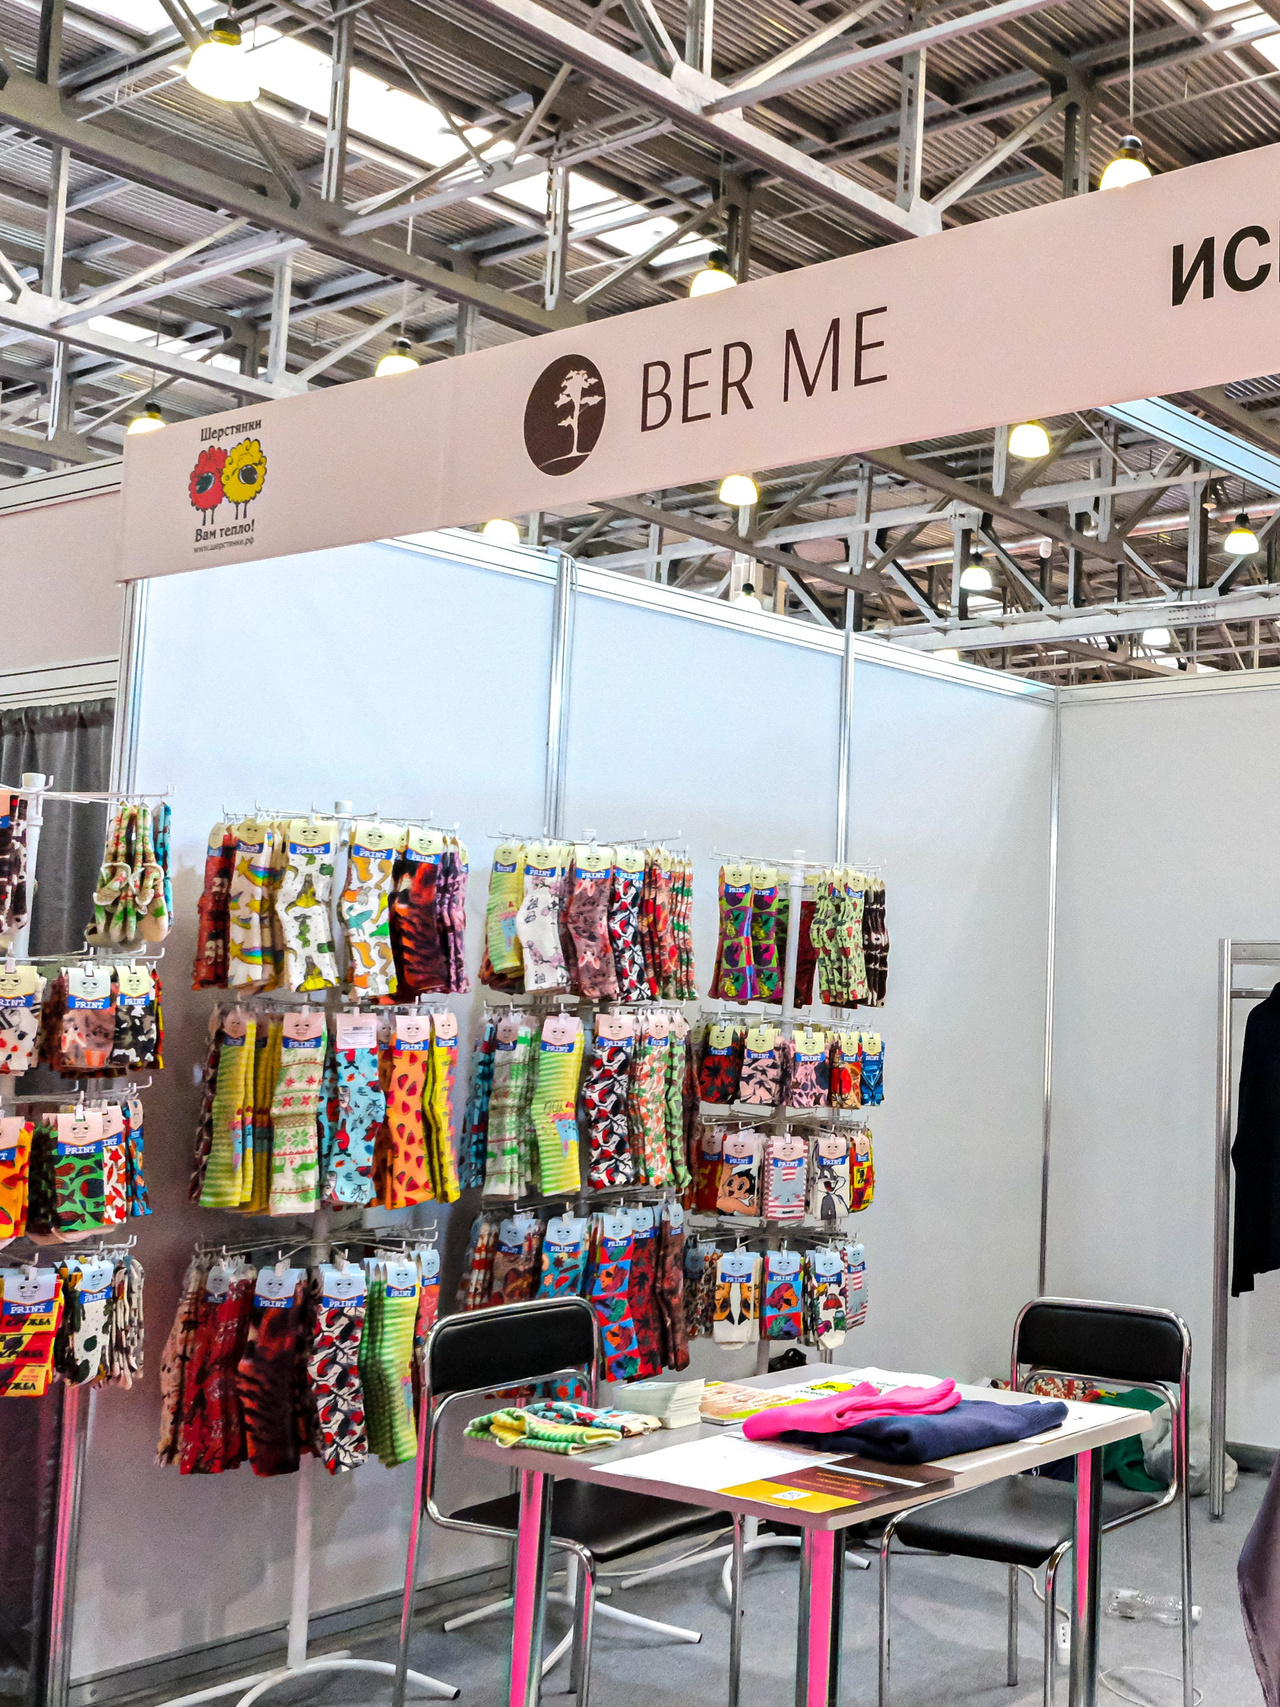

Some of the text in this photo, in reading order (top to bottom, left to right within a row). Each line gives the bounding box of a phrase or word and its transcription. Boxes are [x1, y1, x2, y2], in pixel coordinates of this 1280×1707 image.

[640, 305, 888, 433] BER ME
[200, 419, 262, 442] Шерстянки
[195, 518, 256, 542] Вам тепло!
[296, 846, 325, 854] PRINT
[75, 1000, 104, 1009] PRINT
[102, 1138, 118, 1146] INT
[65, 1145, 96, 1154] PRINT
[259, 1300, 288, 1308] PRINT
[329, 1300, 358, 1308] PRINT
[10, 1305, 46, 1314] PRINT
